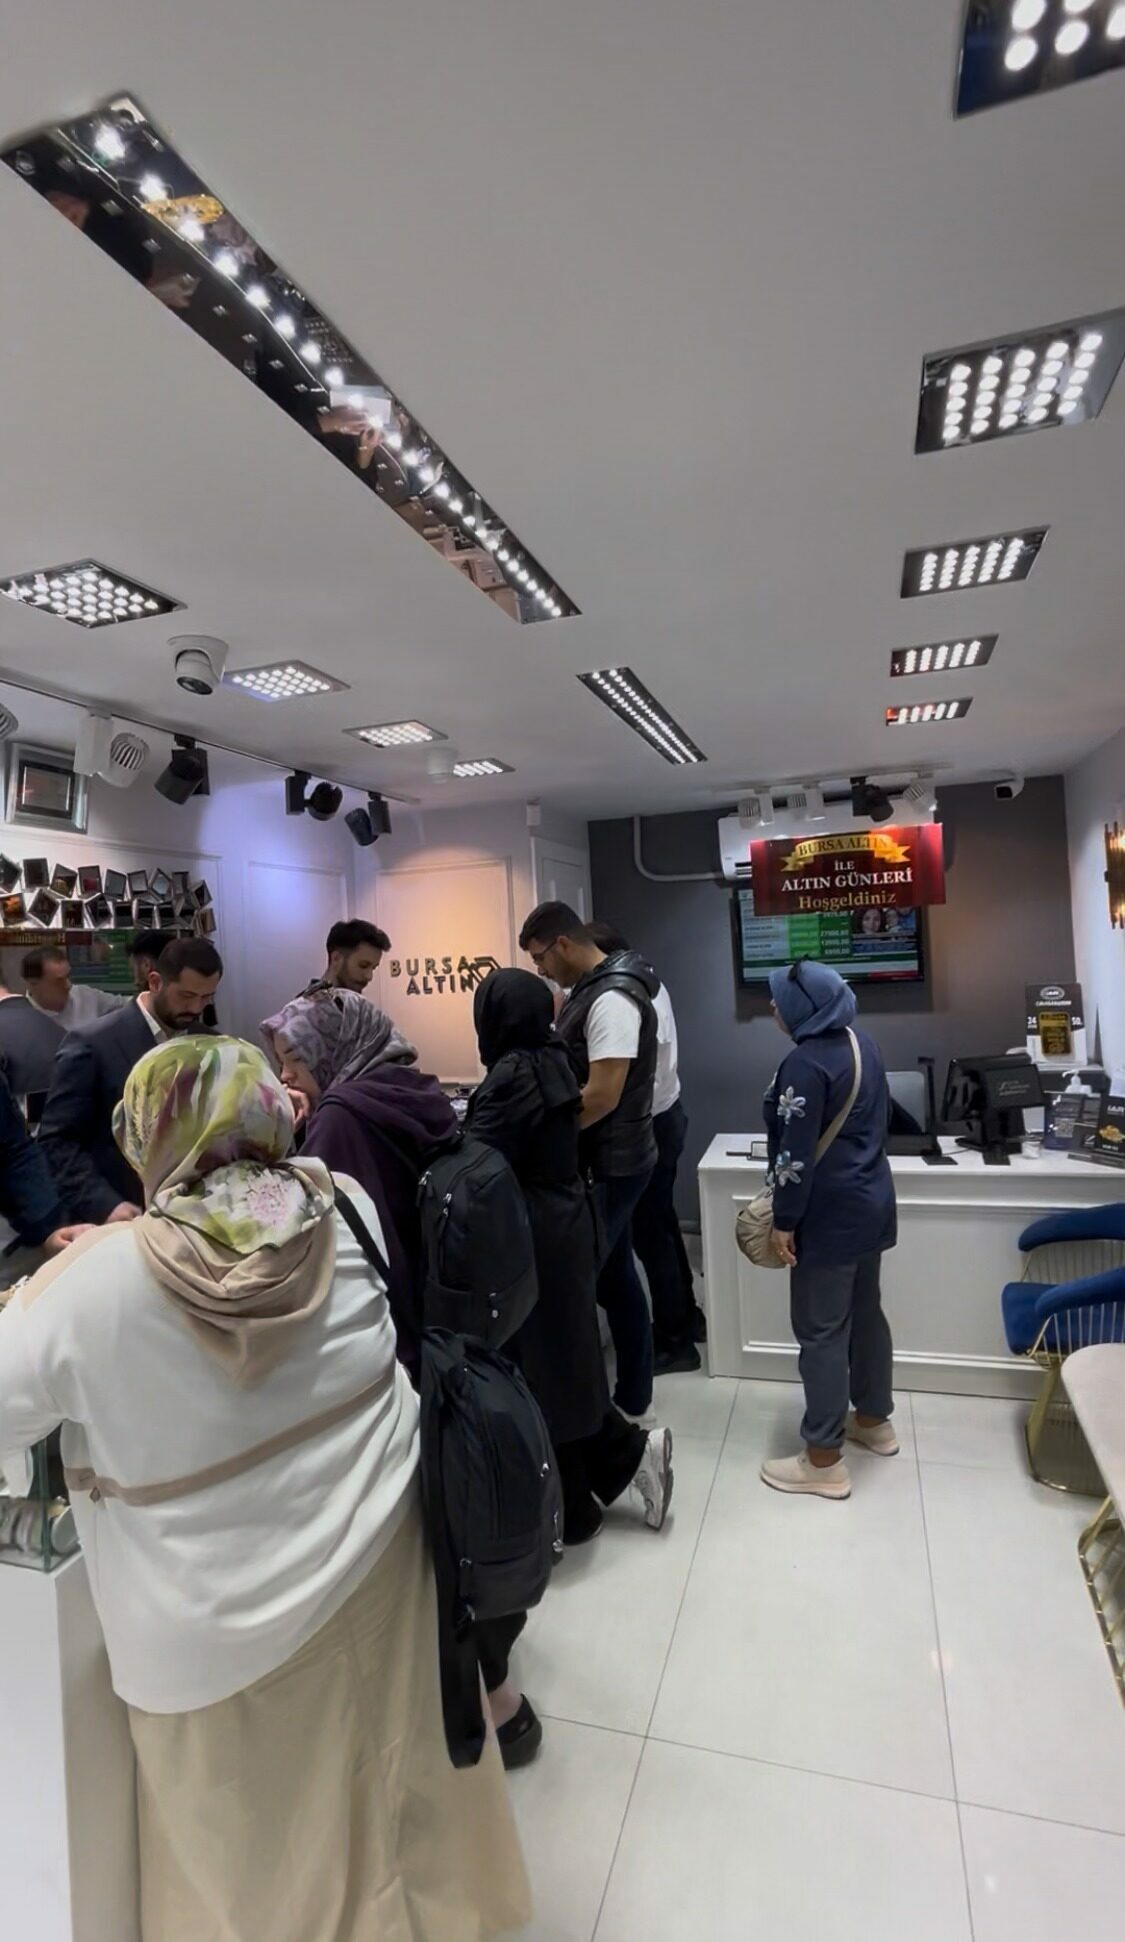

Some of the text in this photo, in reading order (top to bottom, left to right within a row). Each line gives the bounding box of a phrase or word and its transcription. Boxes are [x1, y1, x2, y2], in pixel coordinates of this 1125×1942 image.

[799, 835, 889, 855] BURSA ALTIN
[834, 859, 855, 871] İLE
[781, 867, 913, 892] ALTIN GÜNLERİ
[799, 890, 896, 911] Hoşgeldiniz
[390, 956, 471, 977] BURSA
[406, 974, 474, 995] ALTIN
